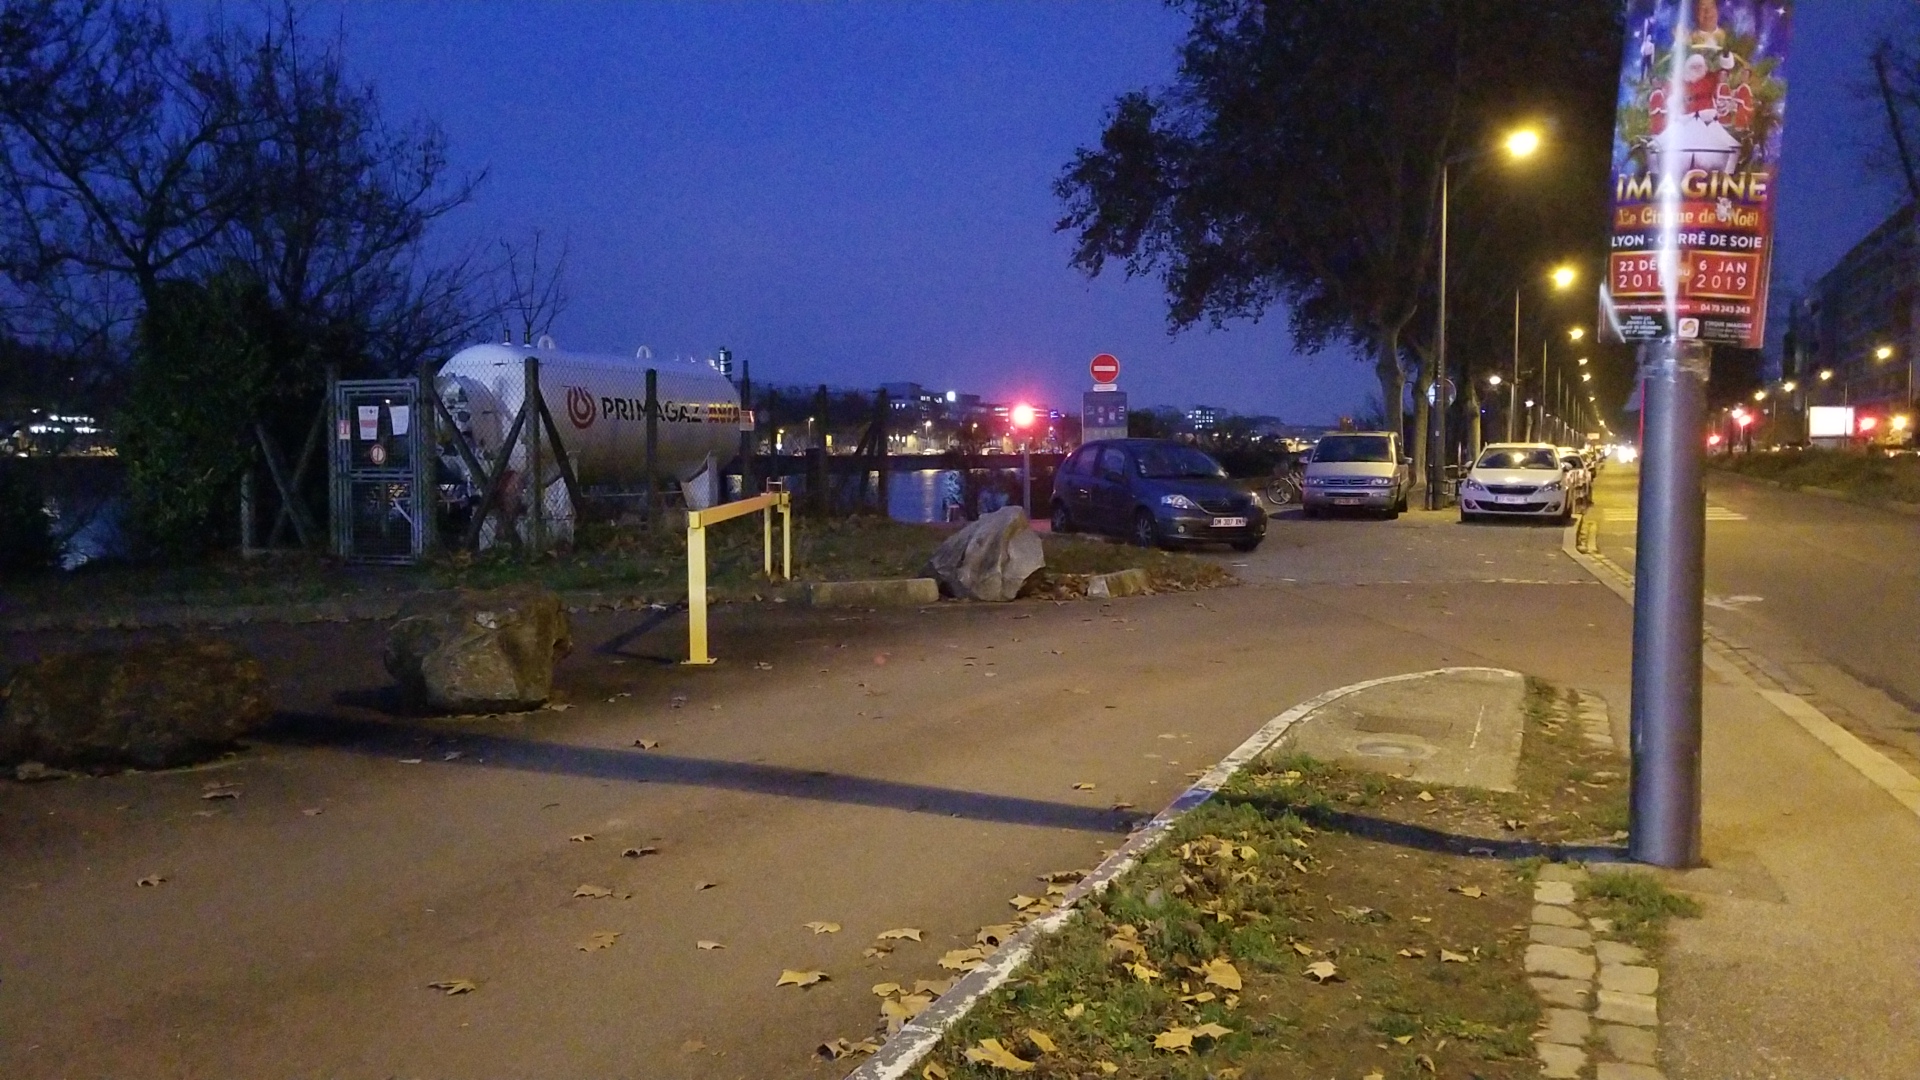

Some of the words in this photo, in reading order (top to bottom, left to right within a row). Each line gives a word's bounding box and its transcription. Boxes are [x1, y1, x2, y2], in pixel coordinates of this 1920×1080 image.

[1616, 169, 1769, 202] IMAGINE
[1618, 208, 1637, 226] Le
[1699, 208, 1717, 224] de
[1611, 234, 1645, 248] LYON
[1709, 235, 1728, 246] DE
[1729, 236, 1763, 249] SOIE
[1619, 261, 1635, 272] 22
[1699, 260, 1708, 271] 6
[1718, 261, 1747, 274] JAN
[1696, 274, 1747, 290] 2019
